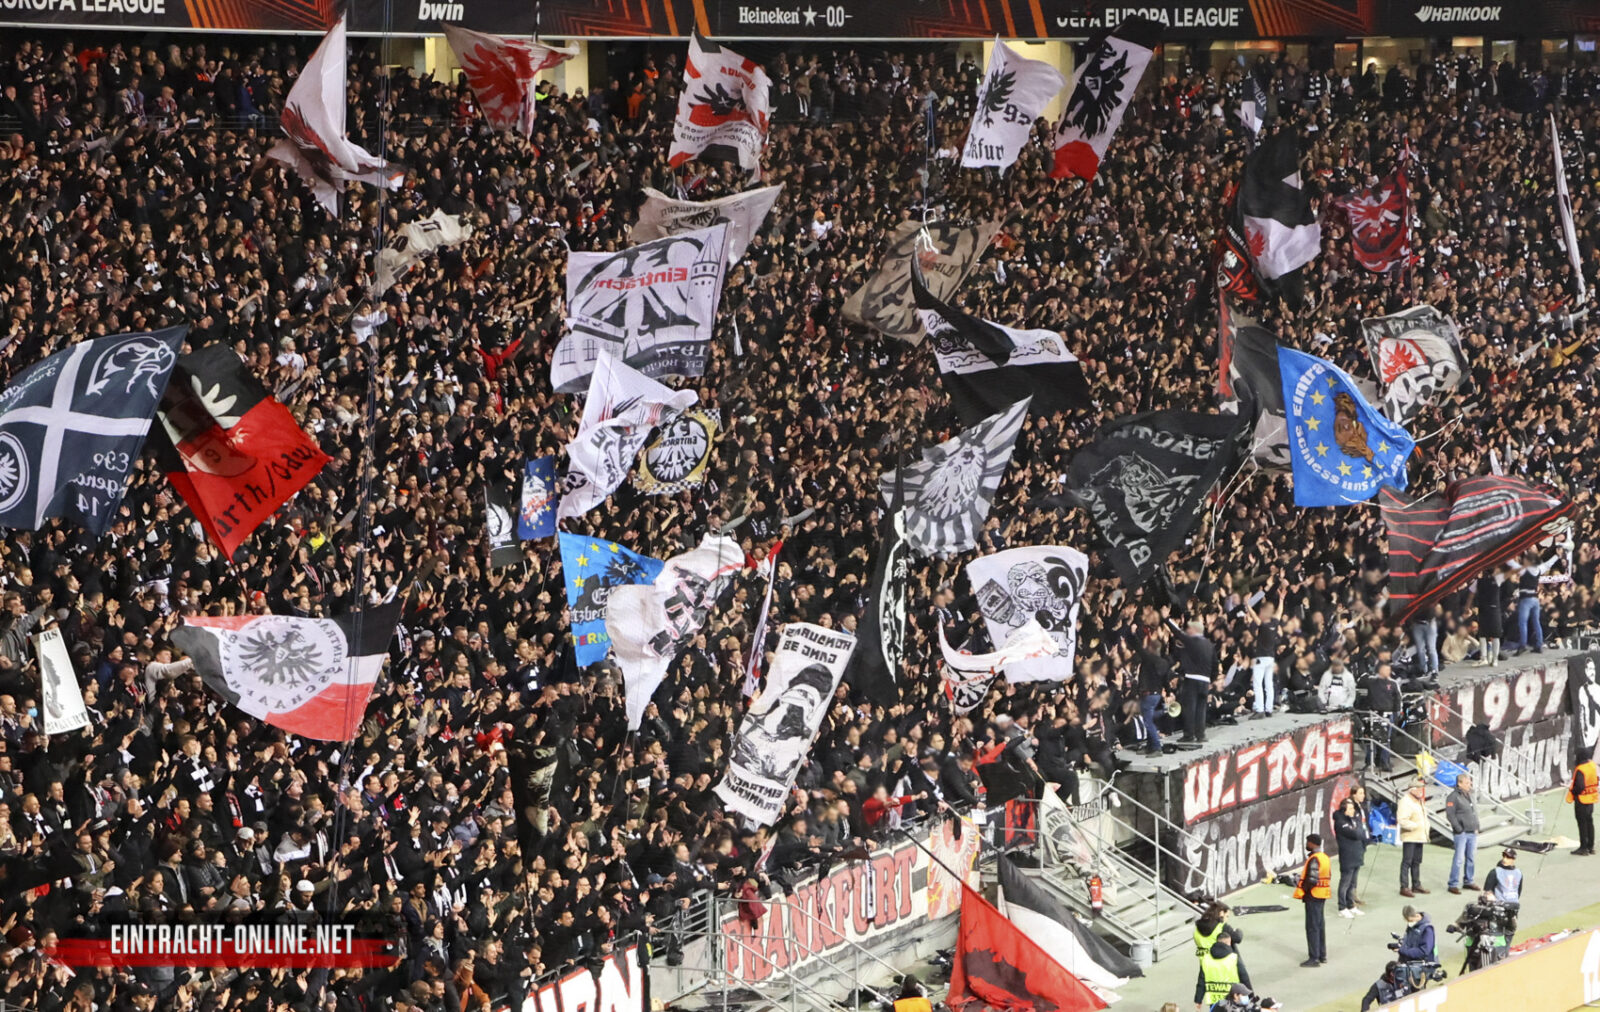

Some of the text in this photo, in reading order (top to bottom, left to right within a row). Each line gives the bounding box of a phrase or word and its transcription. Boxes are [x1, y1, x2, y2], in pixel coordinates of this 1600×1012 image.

[0, 0, 166, 14] UROPA LEAGUE
[418, 0, 465, 21] bwin
[738, 6, 800, 24] Heineken
[1174, 8, 1240, 27] LEAGUE
[1456, 658, 1569, 740] 1997
[1184, 718, 1354, 825] ULTRAS
[1184, 788, 1326, 897] Eintracht
[722, 845, 918, 985] FRANKFURT
